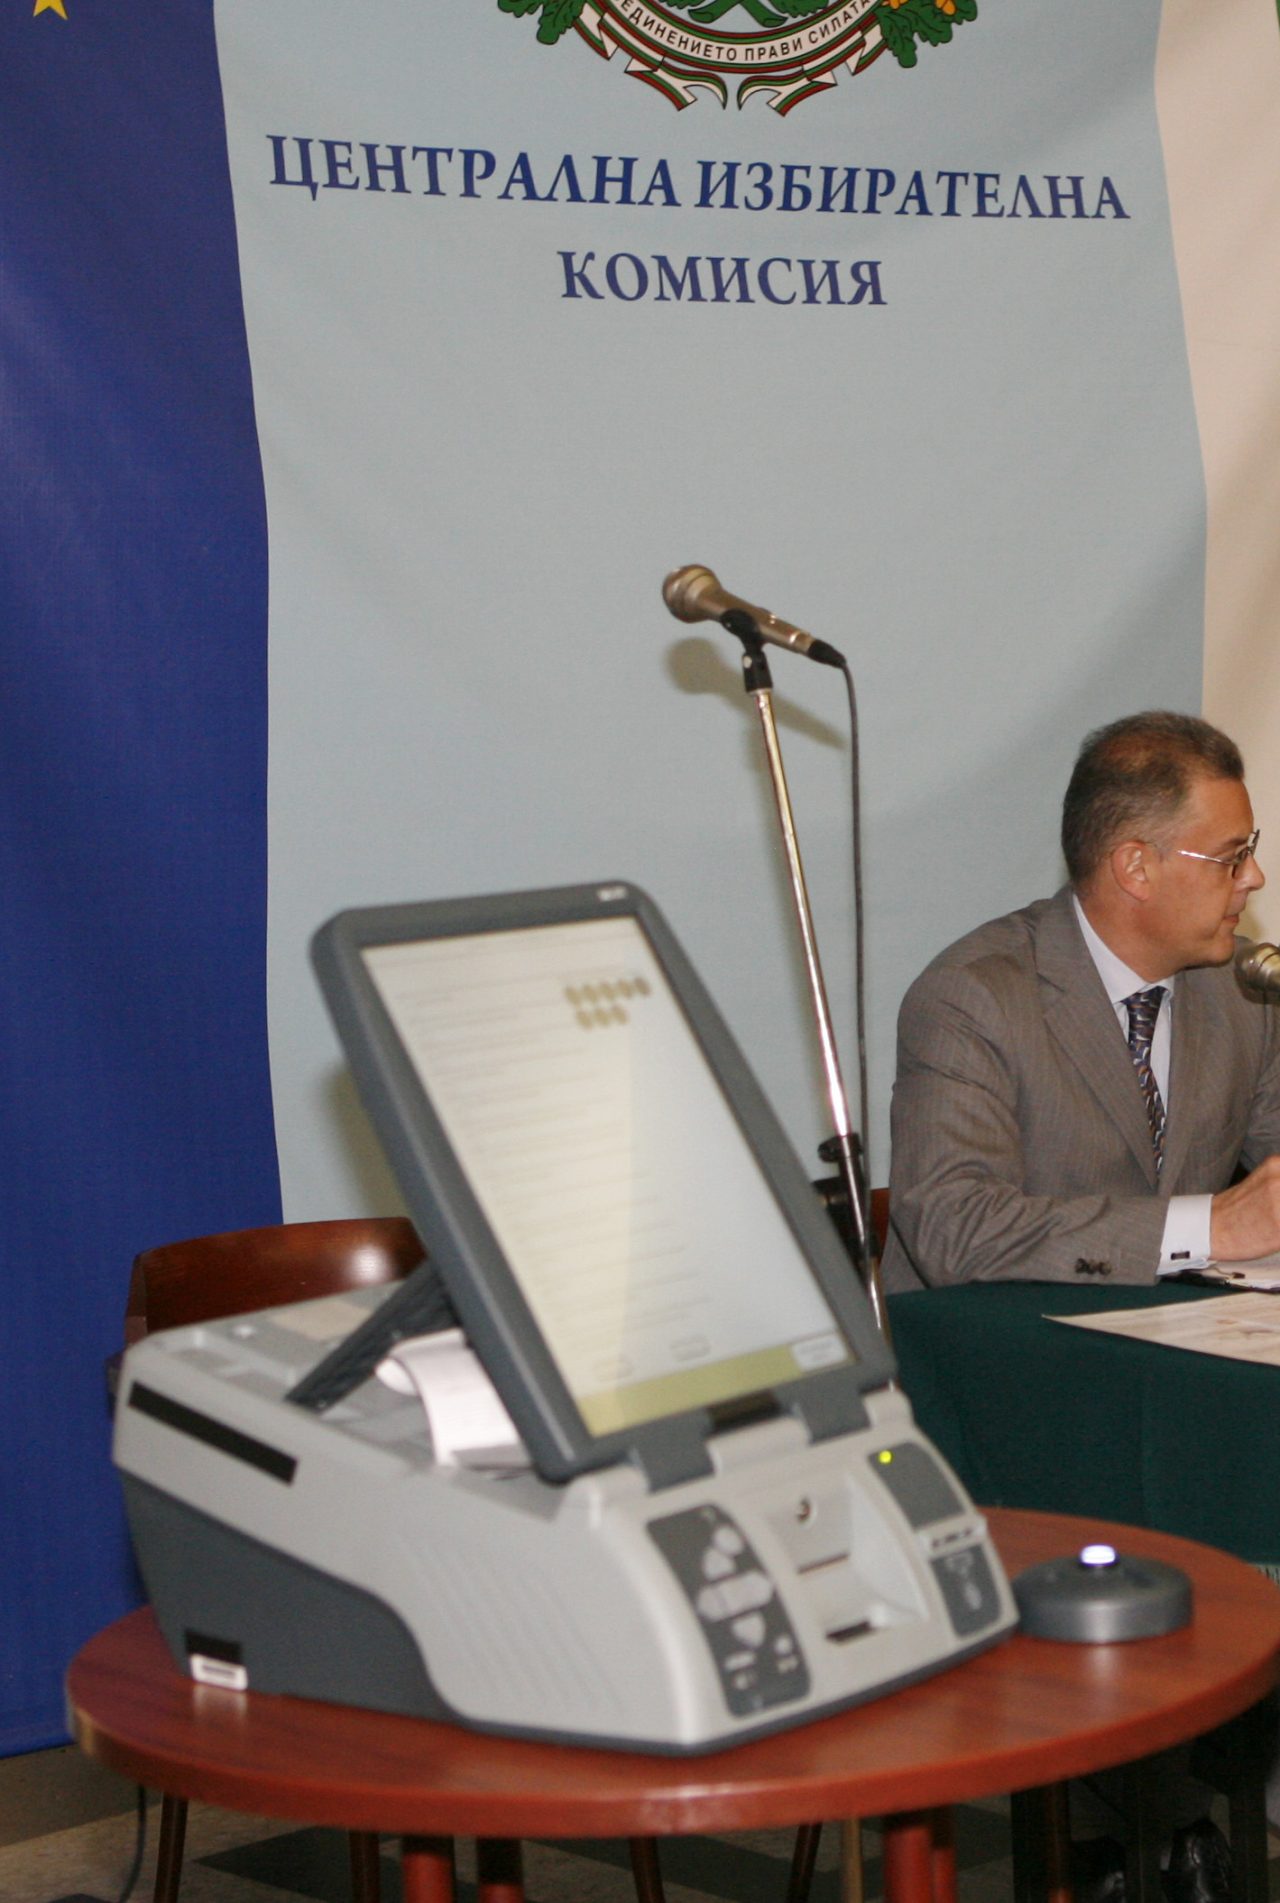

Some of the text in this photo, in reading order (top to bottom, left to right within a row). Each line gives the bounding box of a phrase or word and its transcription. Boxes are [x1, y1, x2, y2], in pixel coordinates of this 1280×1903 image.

[618, 0, 871, 61] ЕДИНЕНИЕТО ПРАВИ СИЛАТА
[266, 134, 1131, 220] ЦЕНТРАЛНА ИЗБИРАТЕЛНА
[557, 250, 888, 305] КОМИСИЯ
